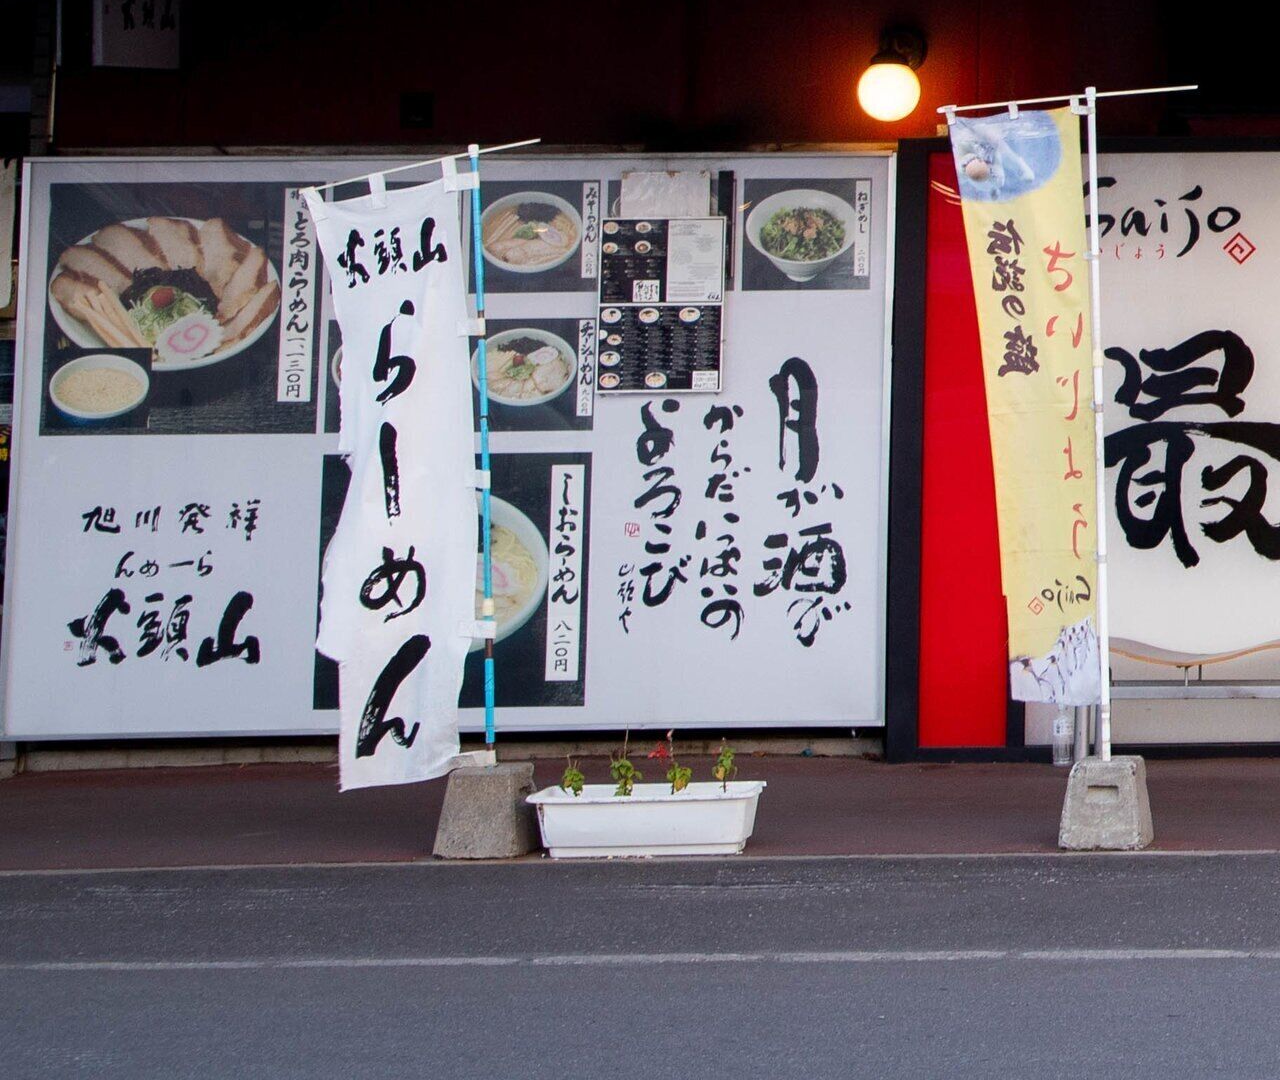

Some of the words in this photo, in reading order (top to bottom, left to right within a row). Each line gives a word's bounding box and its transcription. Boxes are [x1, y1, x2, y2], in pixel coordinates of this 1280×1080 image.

[82, 500, 260, 539] 旭川発祥
[551, 473, 578, 604] しおらーめん
